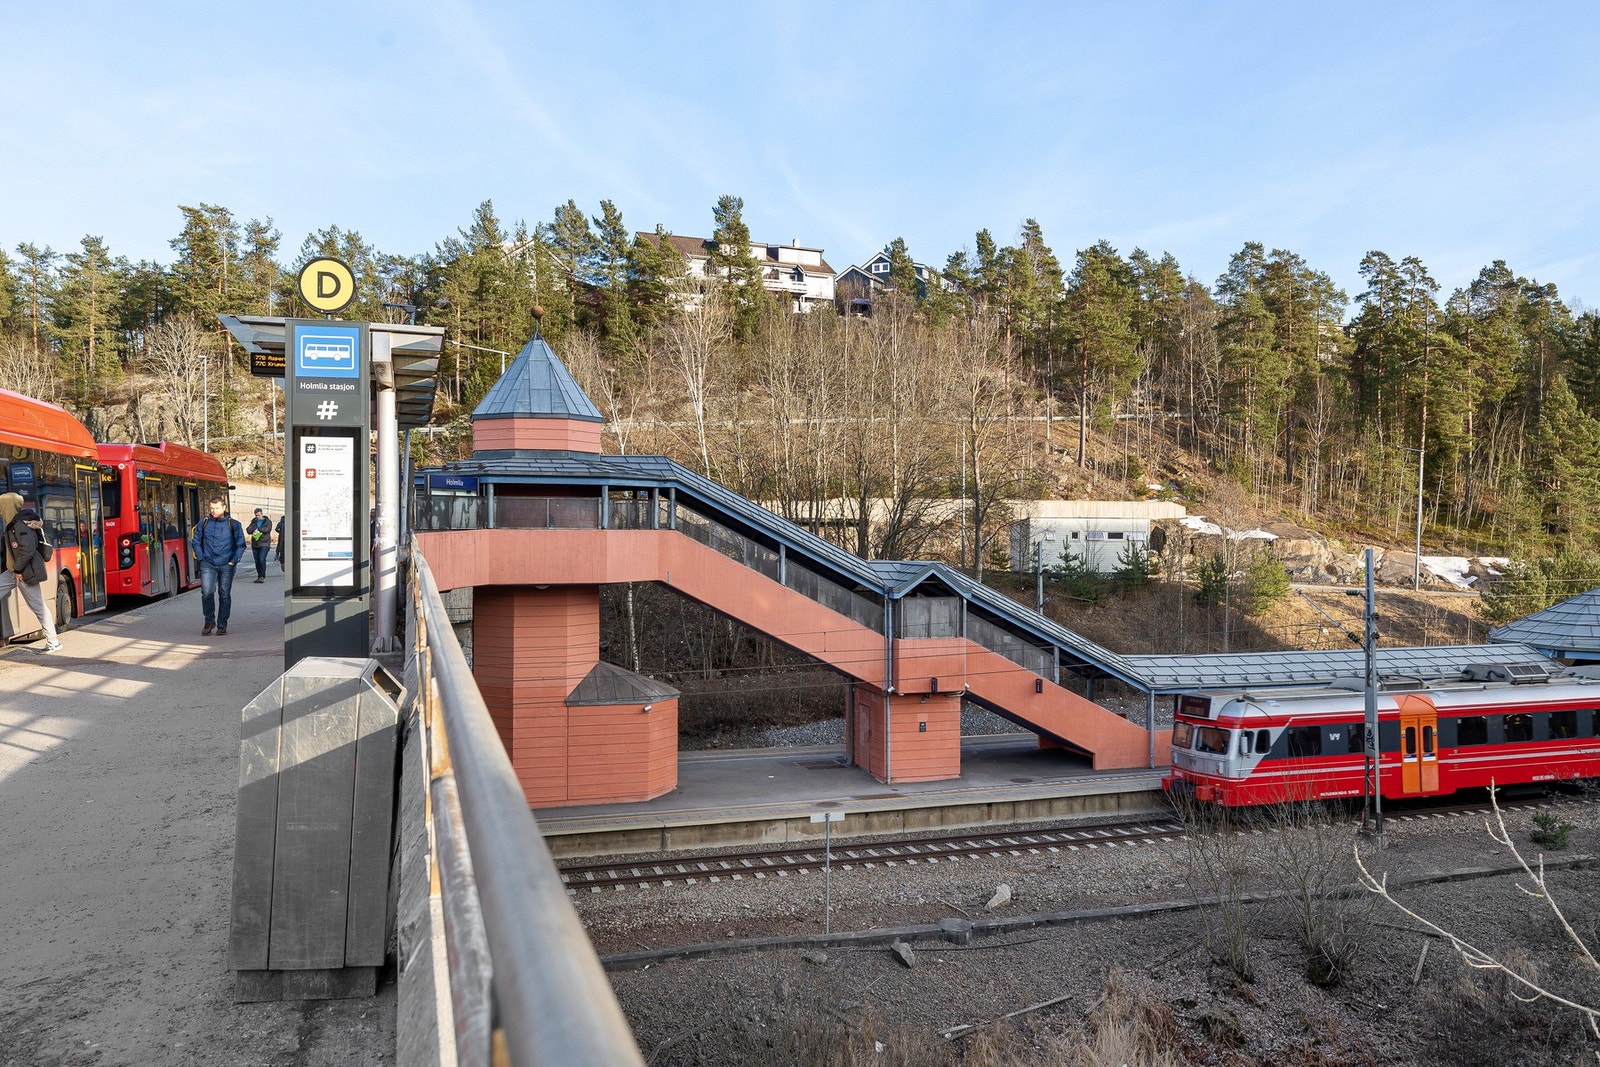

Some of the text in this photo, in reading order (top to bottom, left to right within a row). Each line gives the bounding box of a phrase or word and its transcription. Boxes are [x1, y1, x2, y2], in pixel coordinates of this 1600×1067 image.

[317, 271, 341, 298] D
[300, 382, 355, 392] Holmlia stasjon
